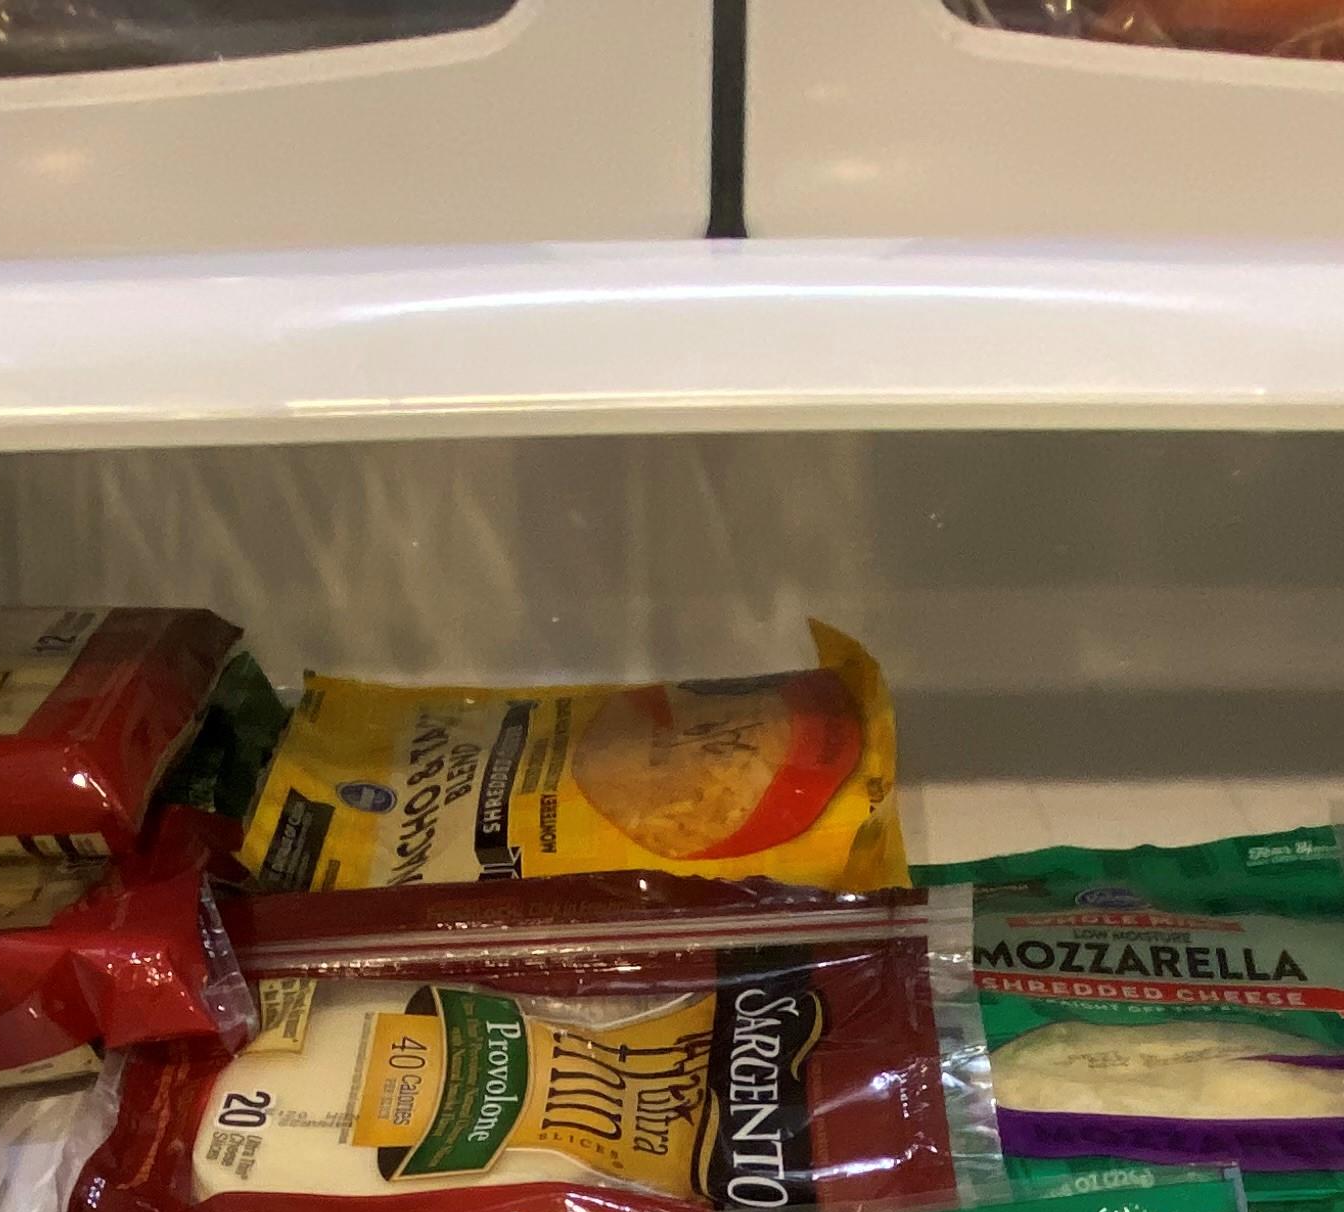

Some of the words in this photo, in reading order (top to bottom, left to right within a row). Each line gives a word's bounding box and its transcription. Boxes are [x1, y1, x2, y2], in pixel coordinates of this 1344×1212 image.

[444, 743, 483, 806] BLEND
[973, 938, 1308, 982] MOZZARELLA
[981, 976, 1165, 1001] SHREDDED
[1176, 985, 1308, 1007] CHEESE
[388, 1035, 429, 1070] 40
[392, 1073, 423, 1127] Calories
[468, 1019, 521, 1143] Provolone
[727, 988, 800, 1208] SARGENTO
[217, 1090, 273, 1129] 20
